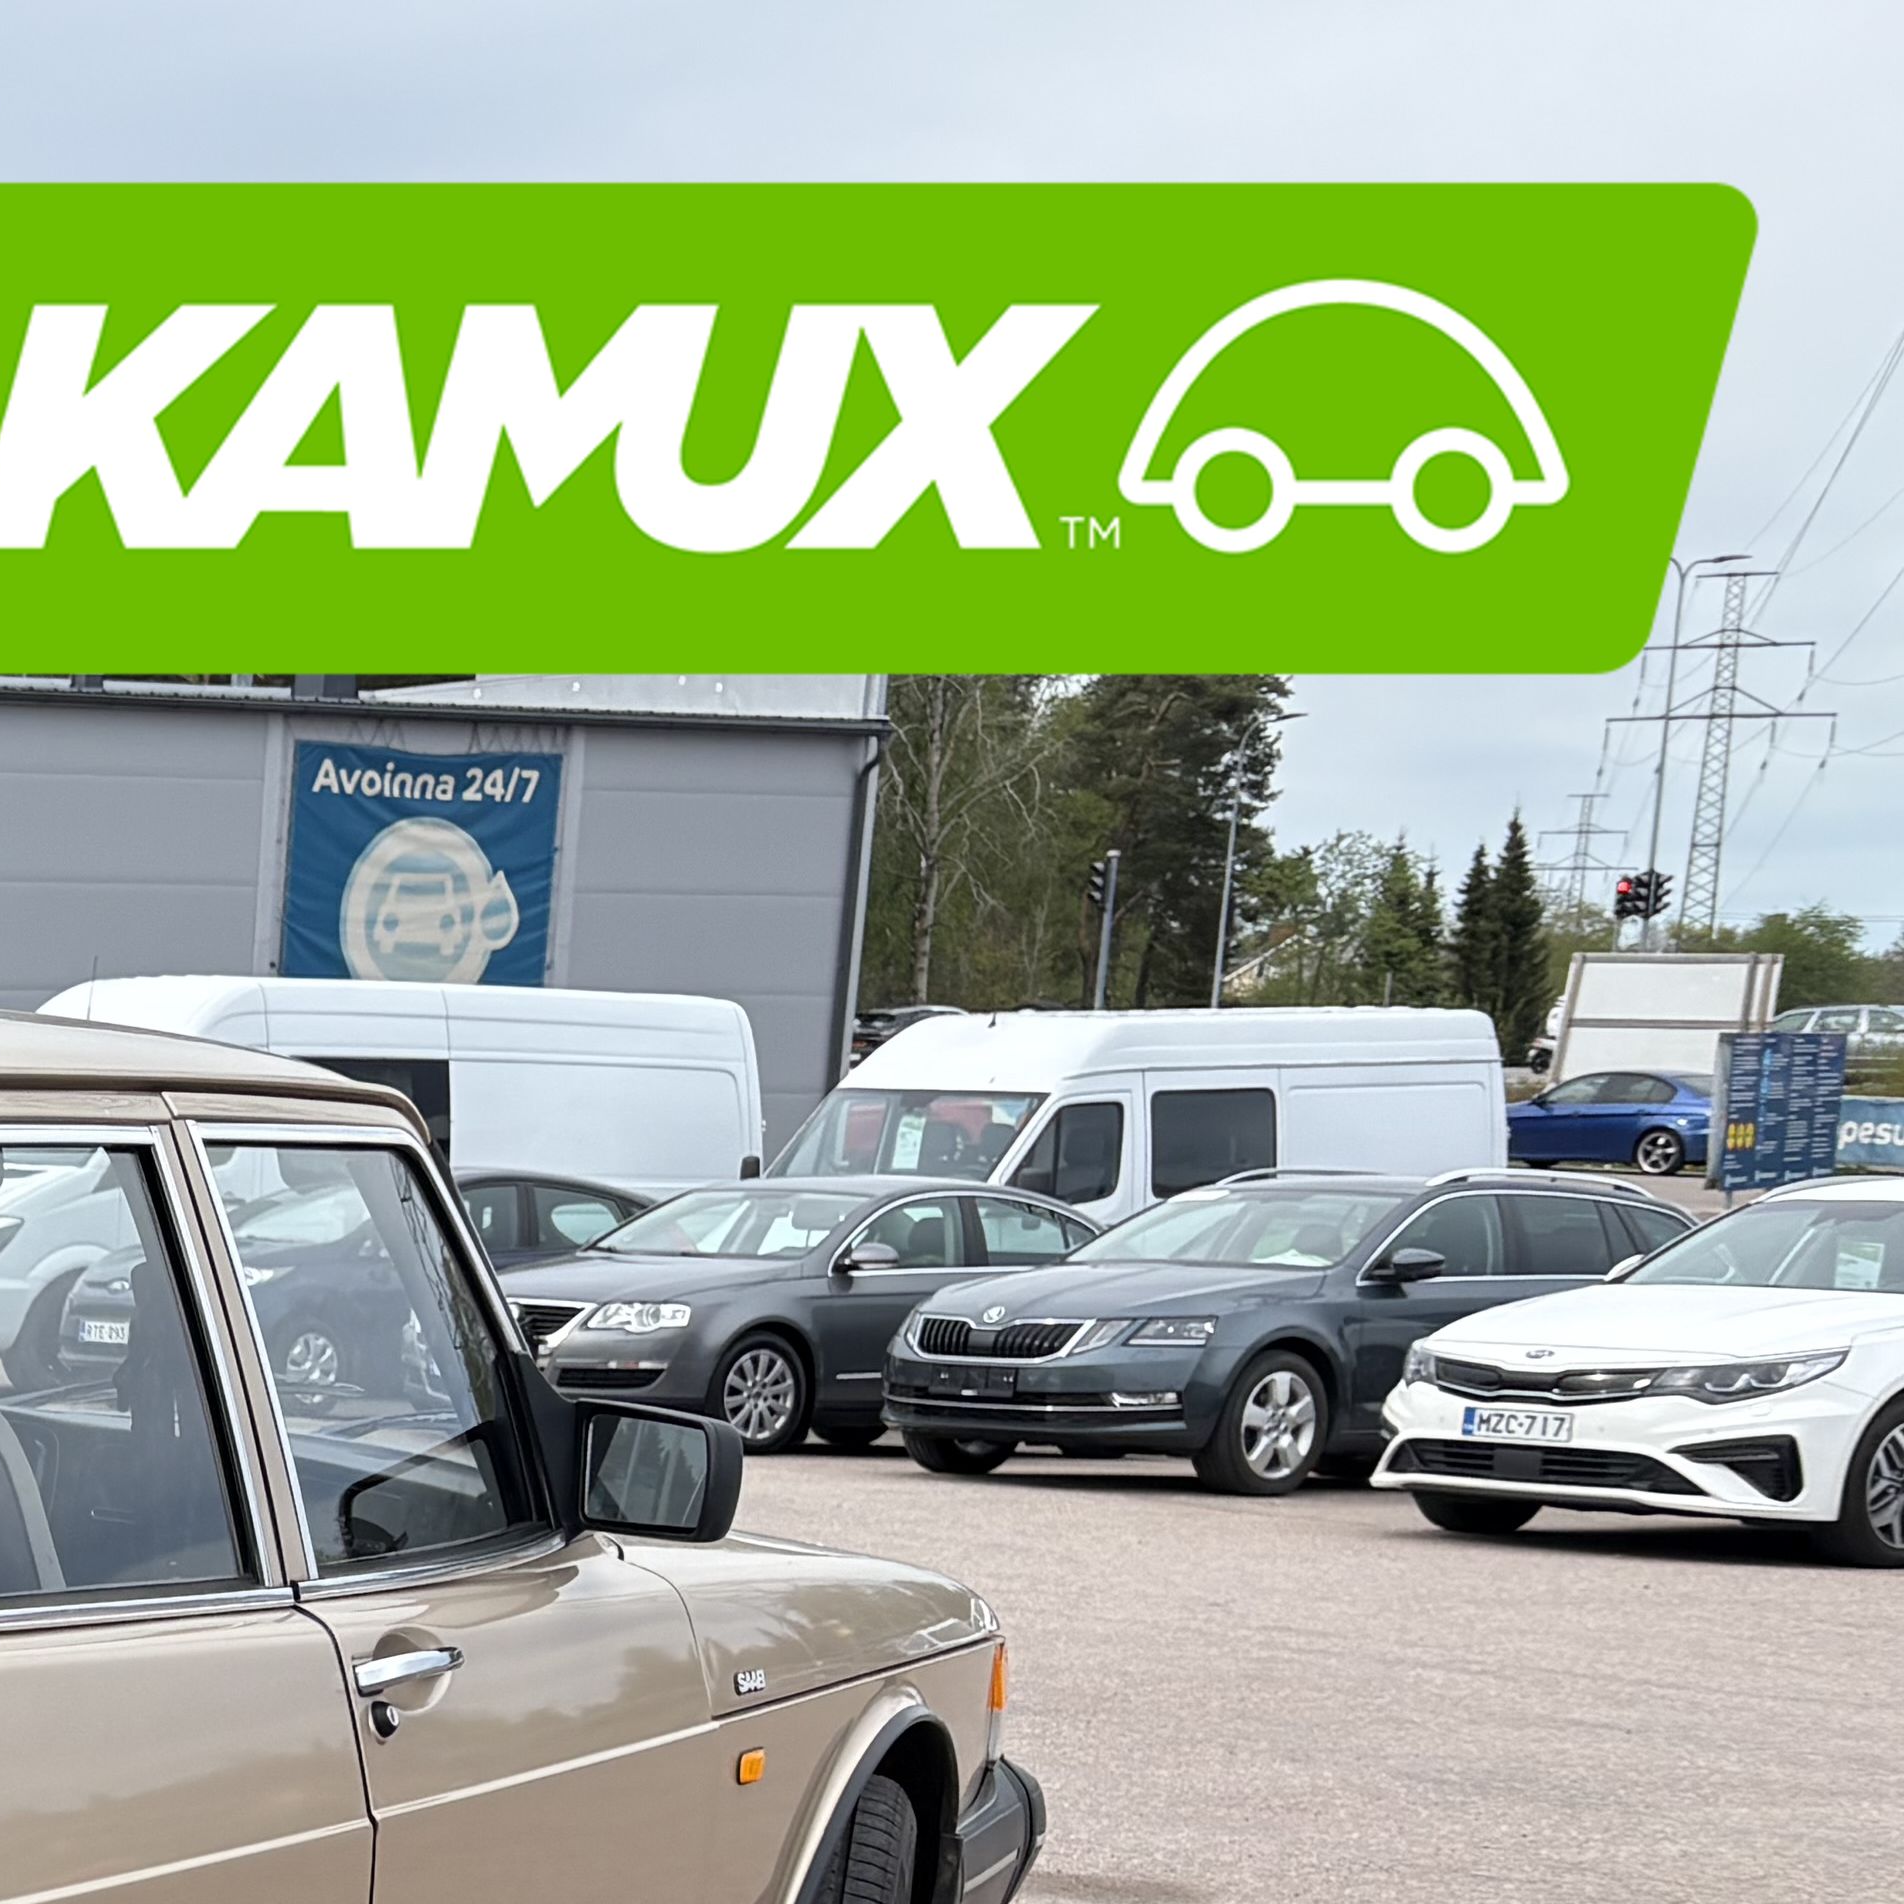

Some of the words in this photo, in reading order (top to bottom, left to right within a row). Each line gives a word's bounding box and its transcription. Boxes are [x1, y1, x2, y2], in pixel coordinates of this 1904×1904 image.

[311, 759, 455, 801] Avoinna
[461, 766, 541, 804] 24/7
[1476, 1412, 1567, 1438] MZC-717
